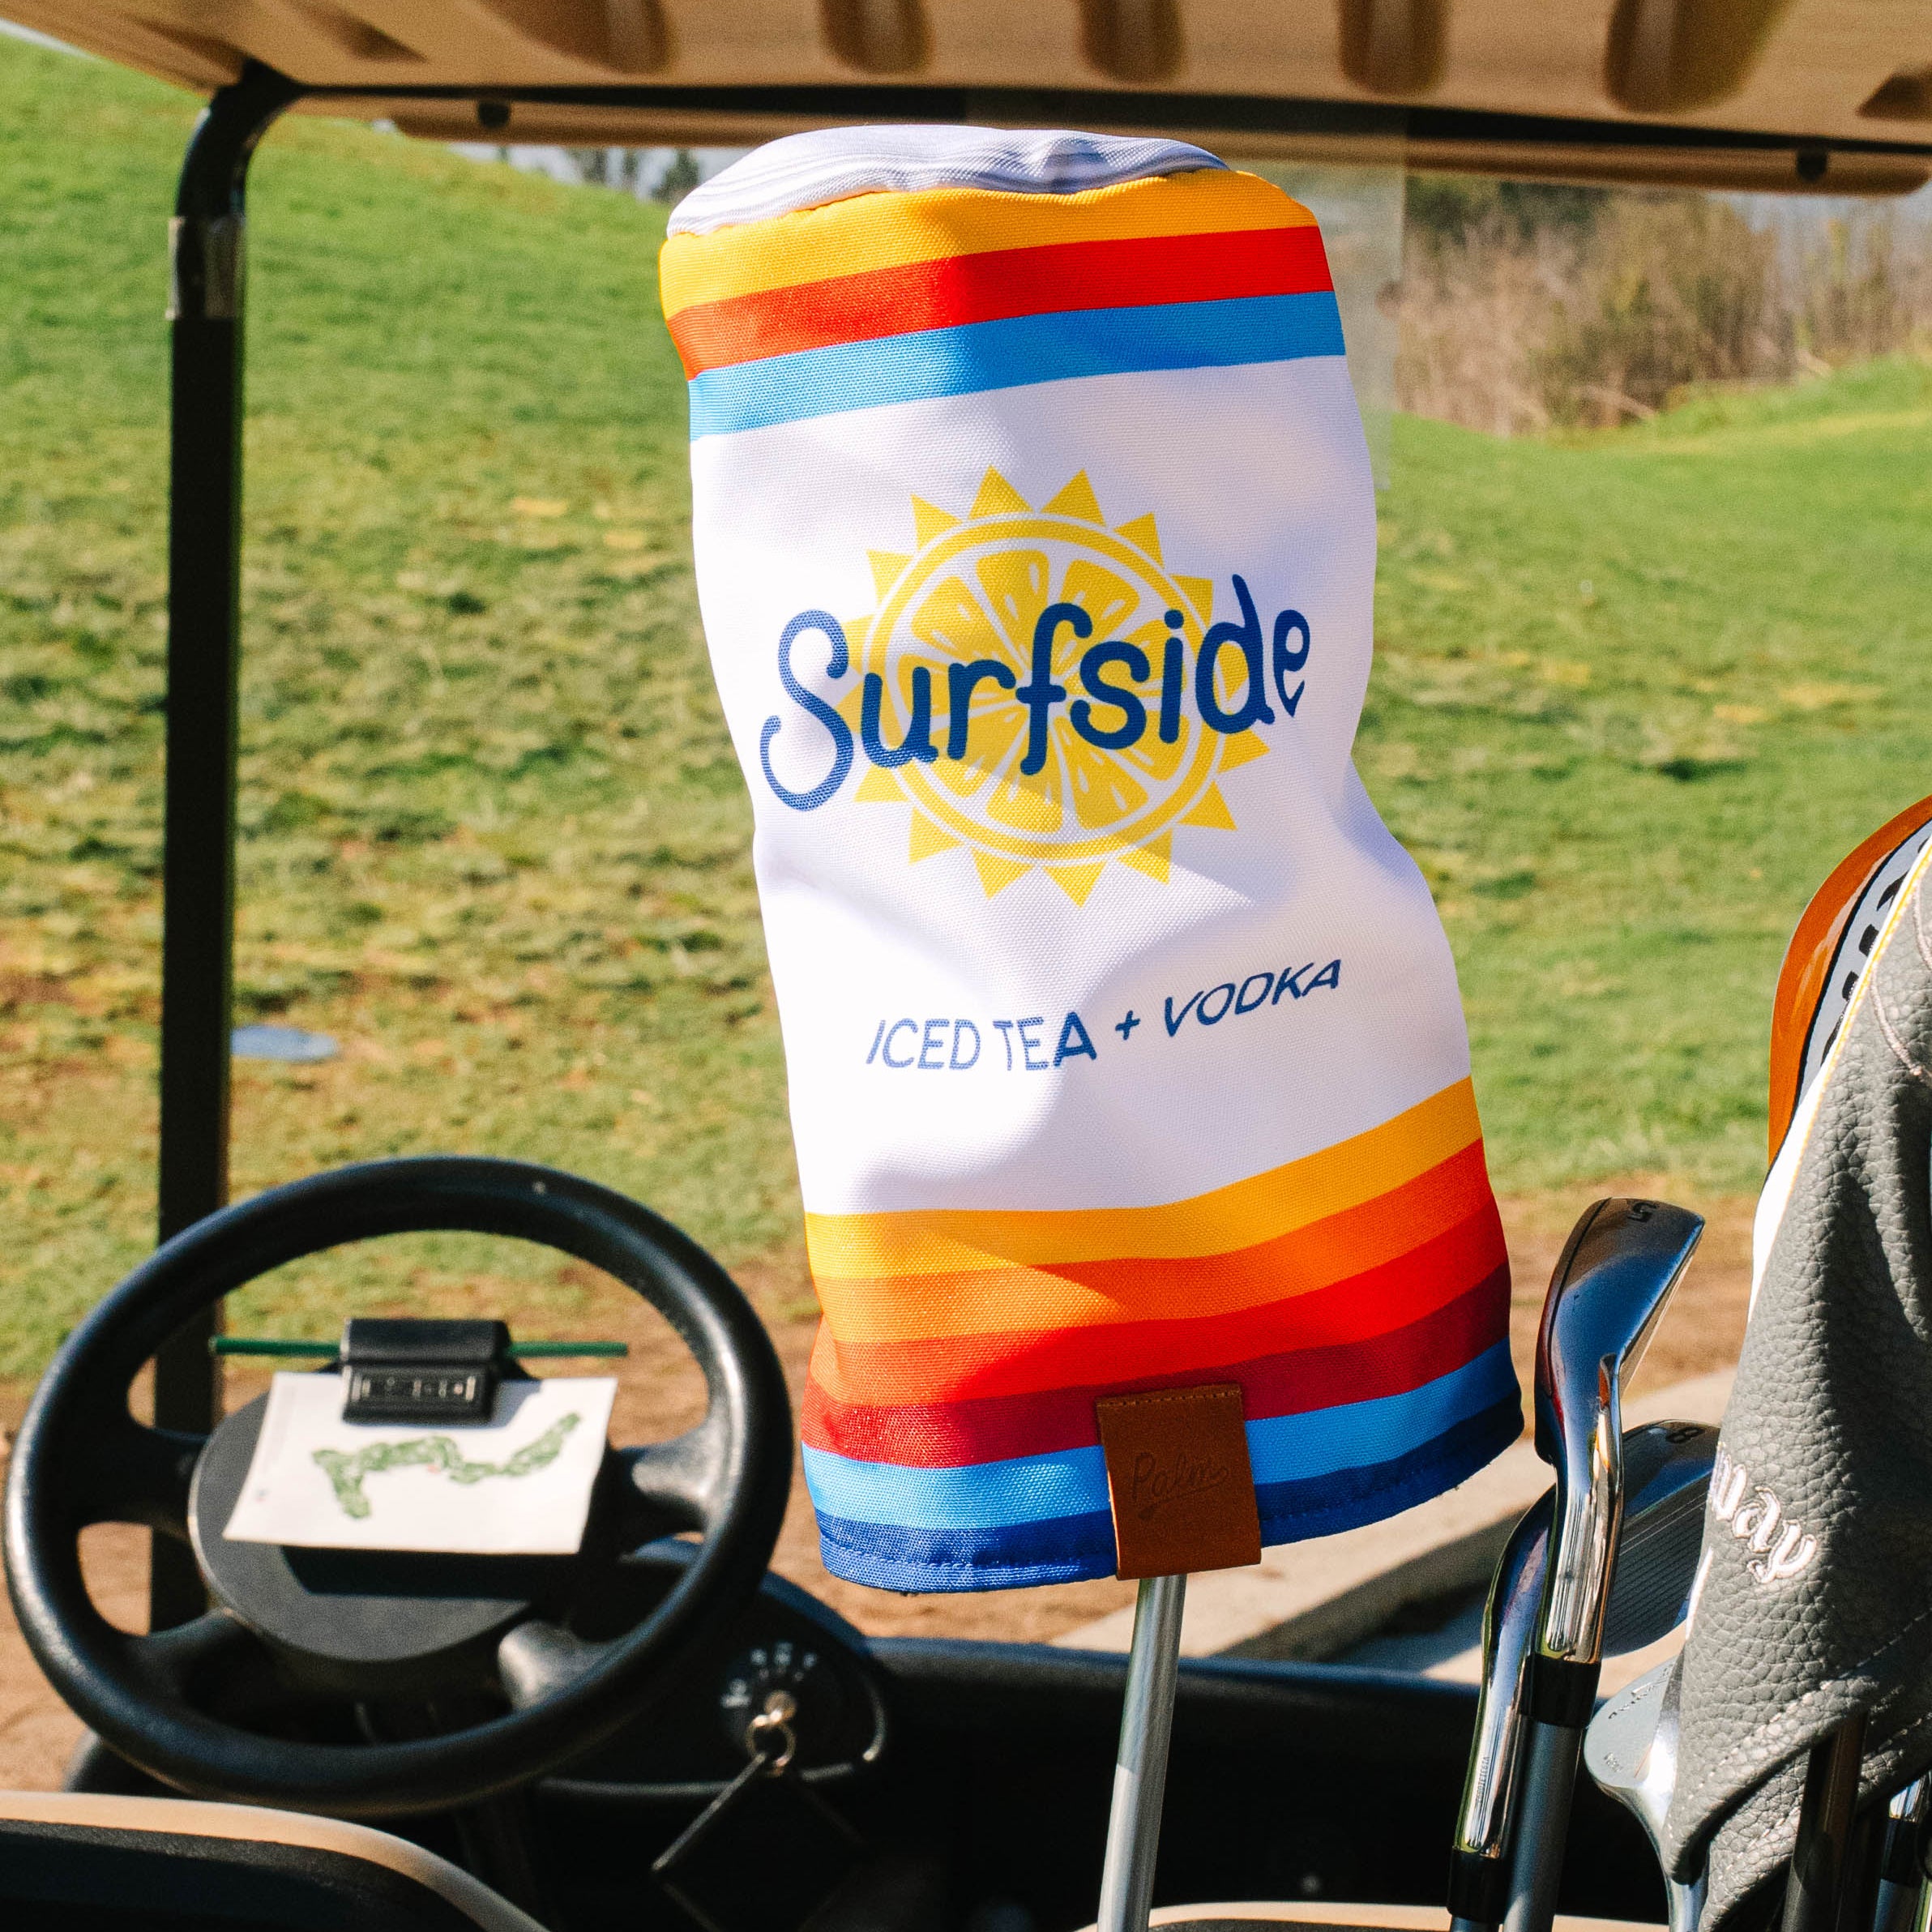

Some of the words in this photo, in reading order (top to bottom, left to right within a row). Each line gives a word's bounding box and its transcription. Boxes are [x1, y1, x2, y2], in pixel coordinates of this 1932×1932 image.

[759, 573, 1311, 812] Surfside
[866, 1018, 981, 1070] ICED
[993, 1011, 1098, 1071] TEA
[1115, 1011, 1141, 1041] +
[1163, 959, 1342, 1038] VODKA
[1665, 1426, 1705, 1444] 8
